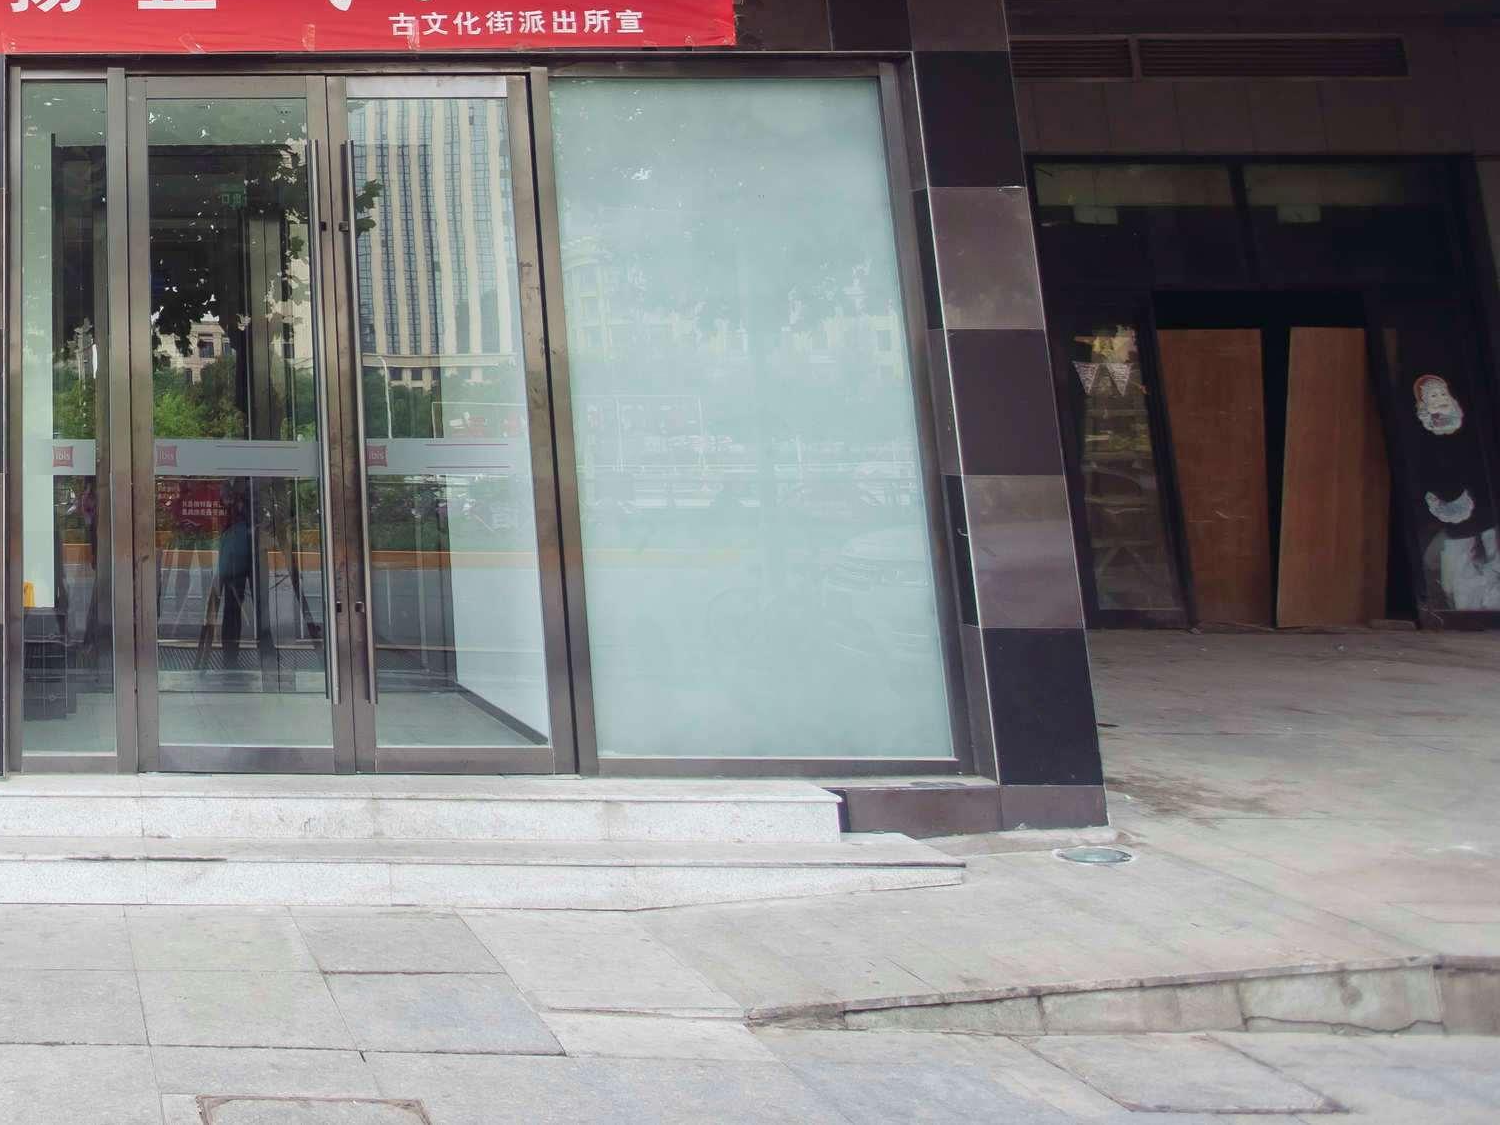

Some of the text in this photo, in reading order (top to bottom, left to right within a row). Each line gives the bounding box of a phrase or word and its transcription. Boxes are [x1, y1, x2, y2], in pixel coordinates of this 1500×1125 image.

[388, 9, 644, 36] 古文化街派出所宣
